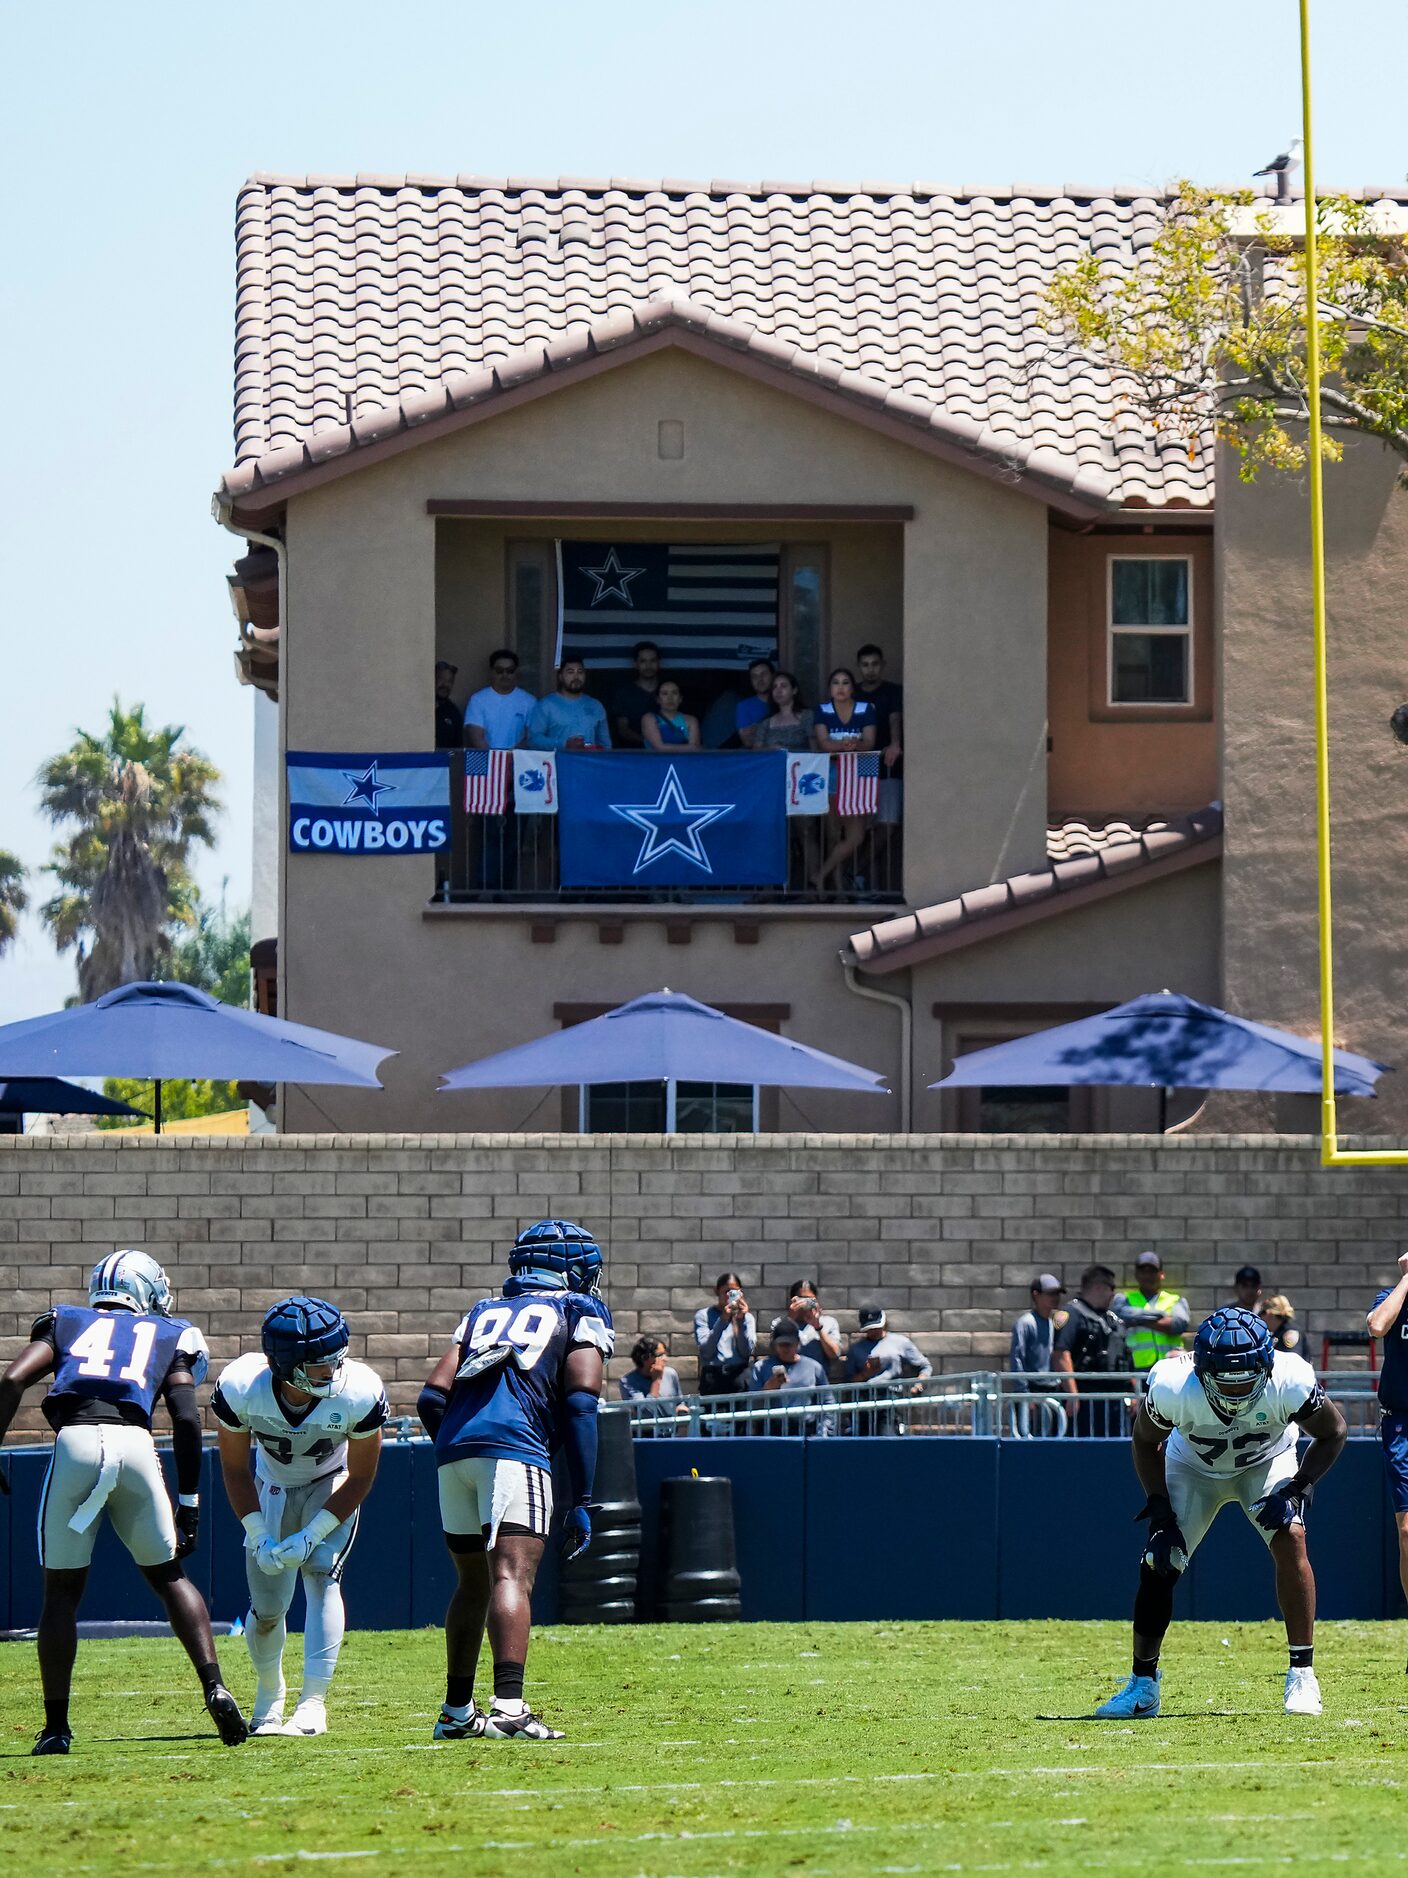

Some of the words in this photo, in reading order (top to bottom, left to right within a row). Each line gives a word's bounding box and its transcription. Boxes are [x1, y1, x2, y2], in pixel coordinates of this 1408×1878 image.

[293, 818, 447, 848] COWBOYS
[69, 1317, 157, 1389] 41
[1188, 1432, 1271, 1468] 72
